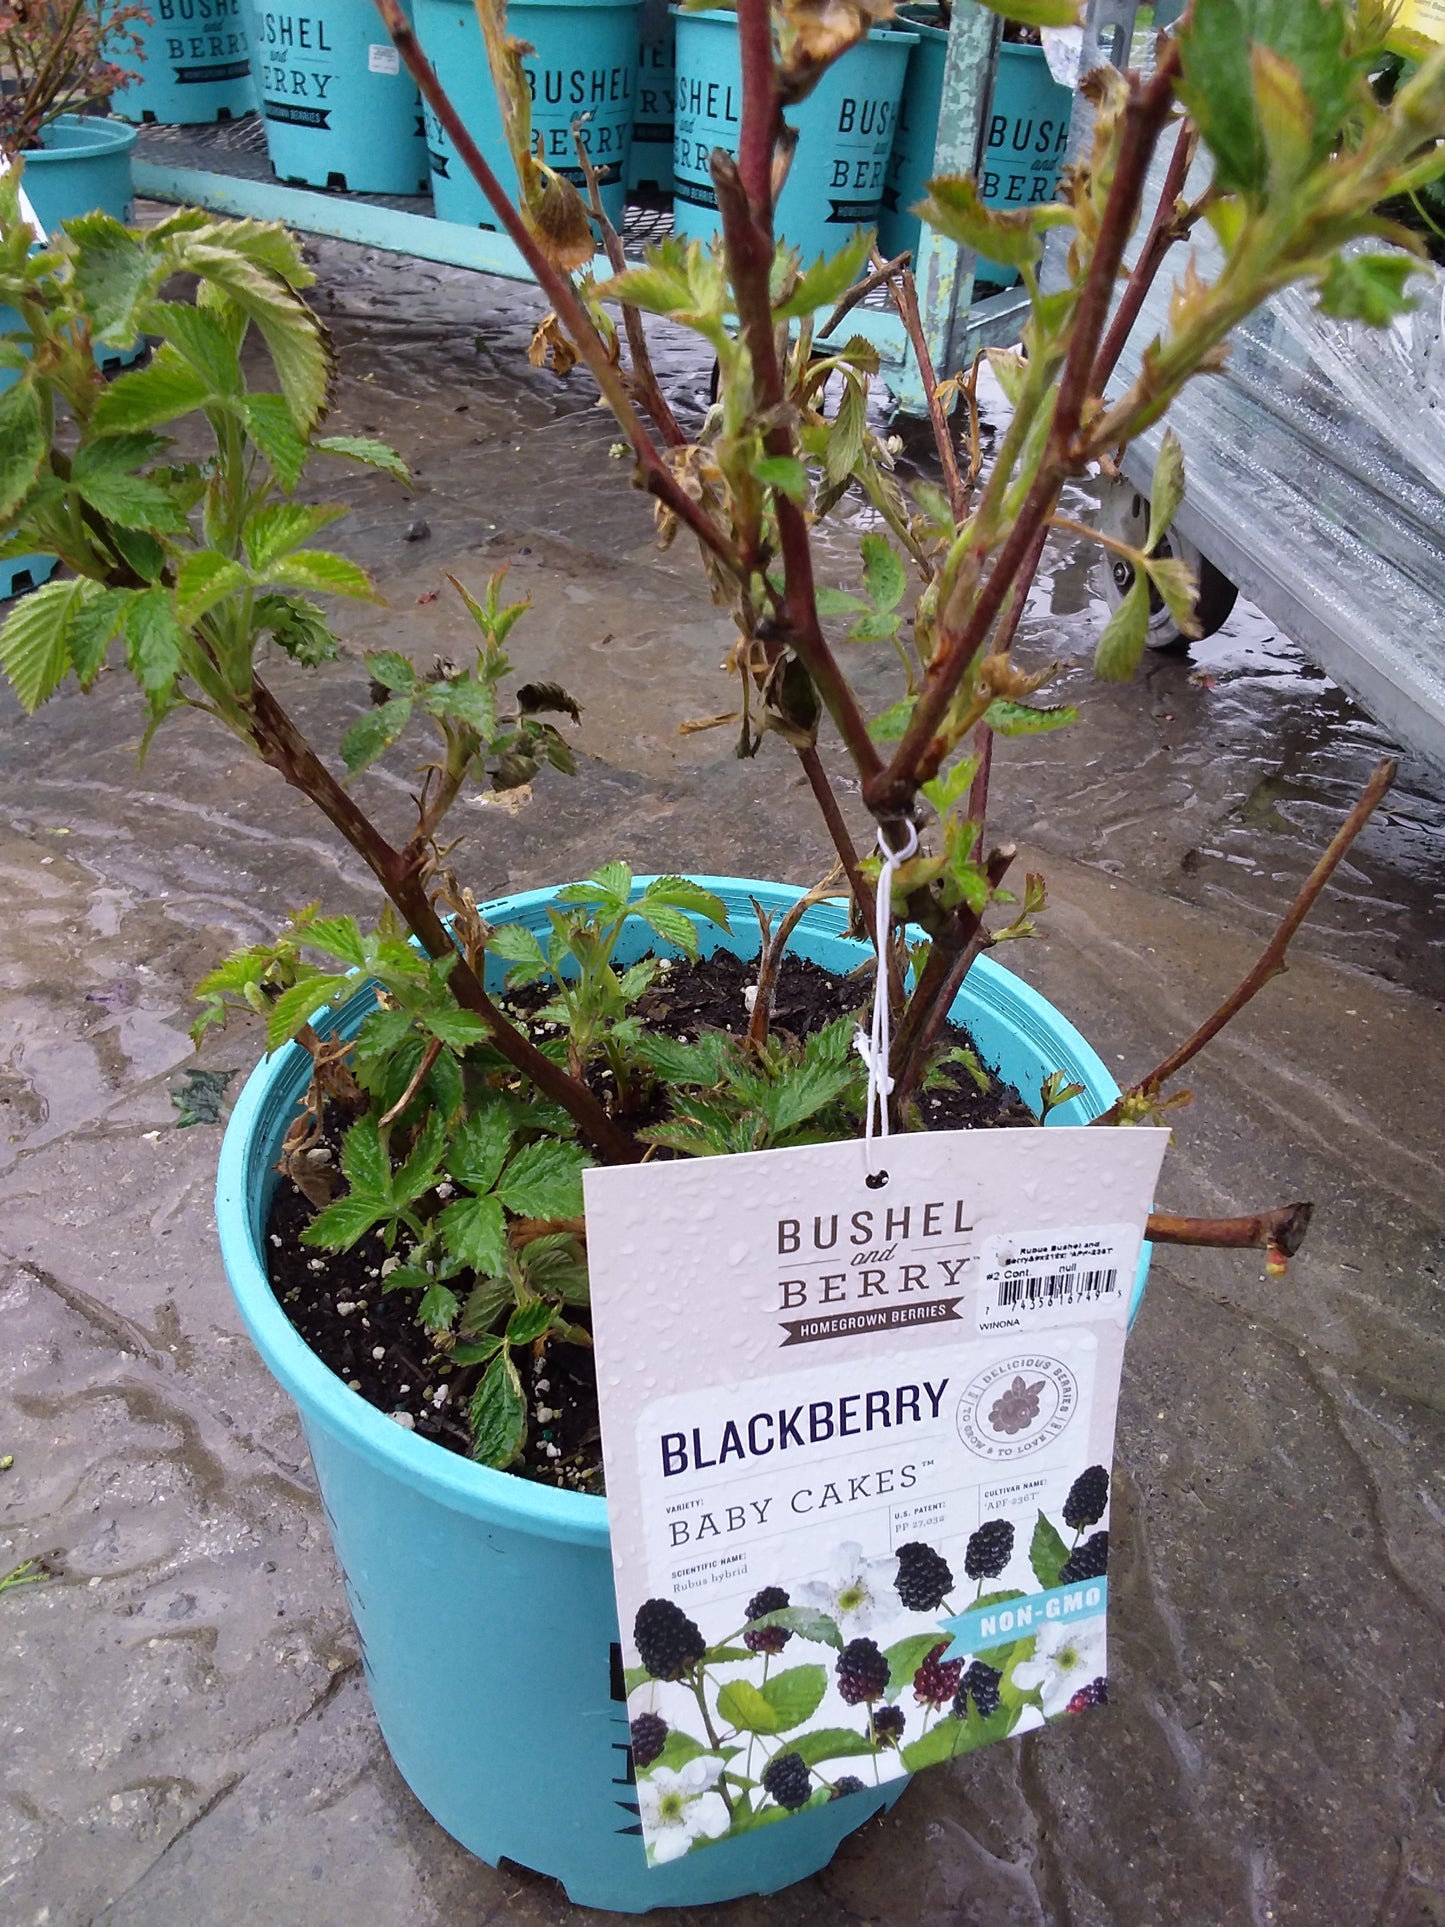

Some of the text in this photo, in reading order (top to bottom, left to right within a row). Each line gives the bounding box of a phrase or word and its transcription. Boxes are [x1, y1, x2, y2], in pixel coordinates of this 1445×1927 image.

[778, 1199, 974, 1254] BUSHEL
[850, 1243, 898, 1267] and
[1059, 1263, 1077, 1273] null
[800, 1304, 946, 1337] HOMEGROWN BERRIES
[979, 1318, 1020, 1331] WINONA
[660, 1378, 949, 1477] BLACKBERRY
[984, 1484, 1021, 1498] CULTIVAR
[666, 1499, 704, 1514] VARIETY:
[894, 1501, 946, 1520] U.S. PATENT:
[669, 1498, 772, 1547] BABY
[895, 1521, 909, 1533] PP
[672, 1552, 747, 1580] SCIENTIFIC NAME:
[673, 1564, 748, 1593] Rubus hybrid
[981, 1587, 1101, 1638] NON-GMO
